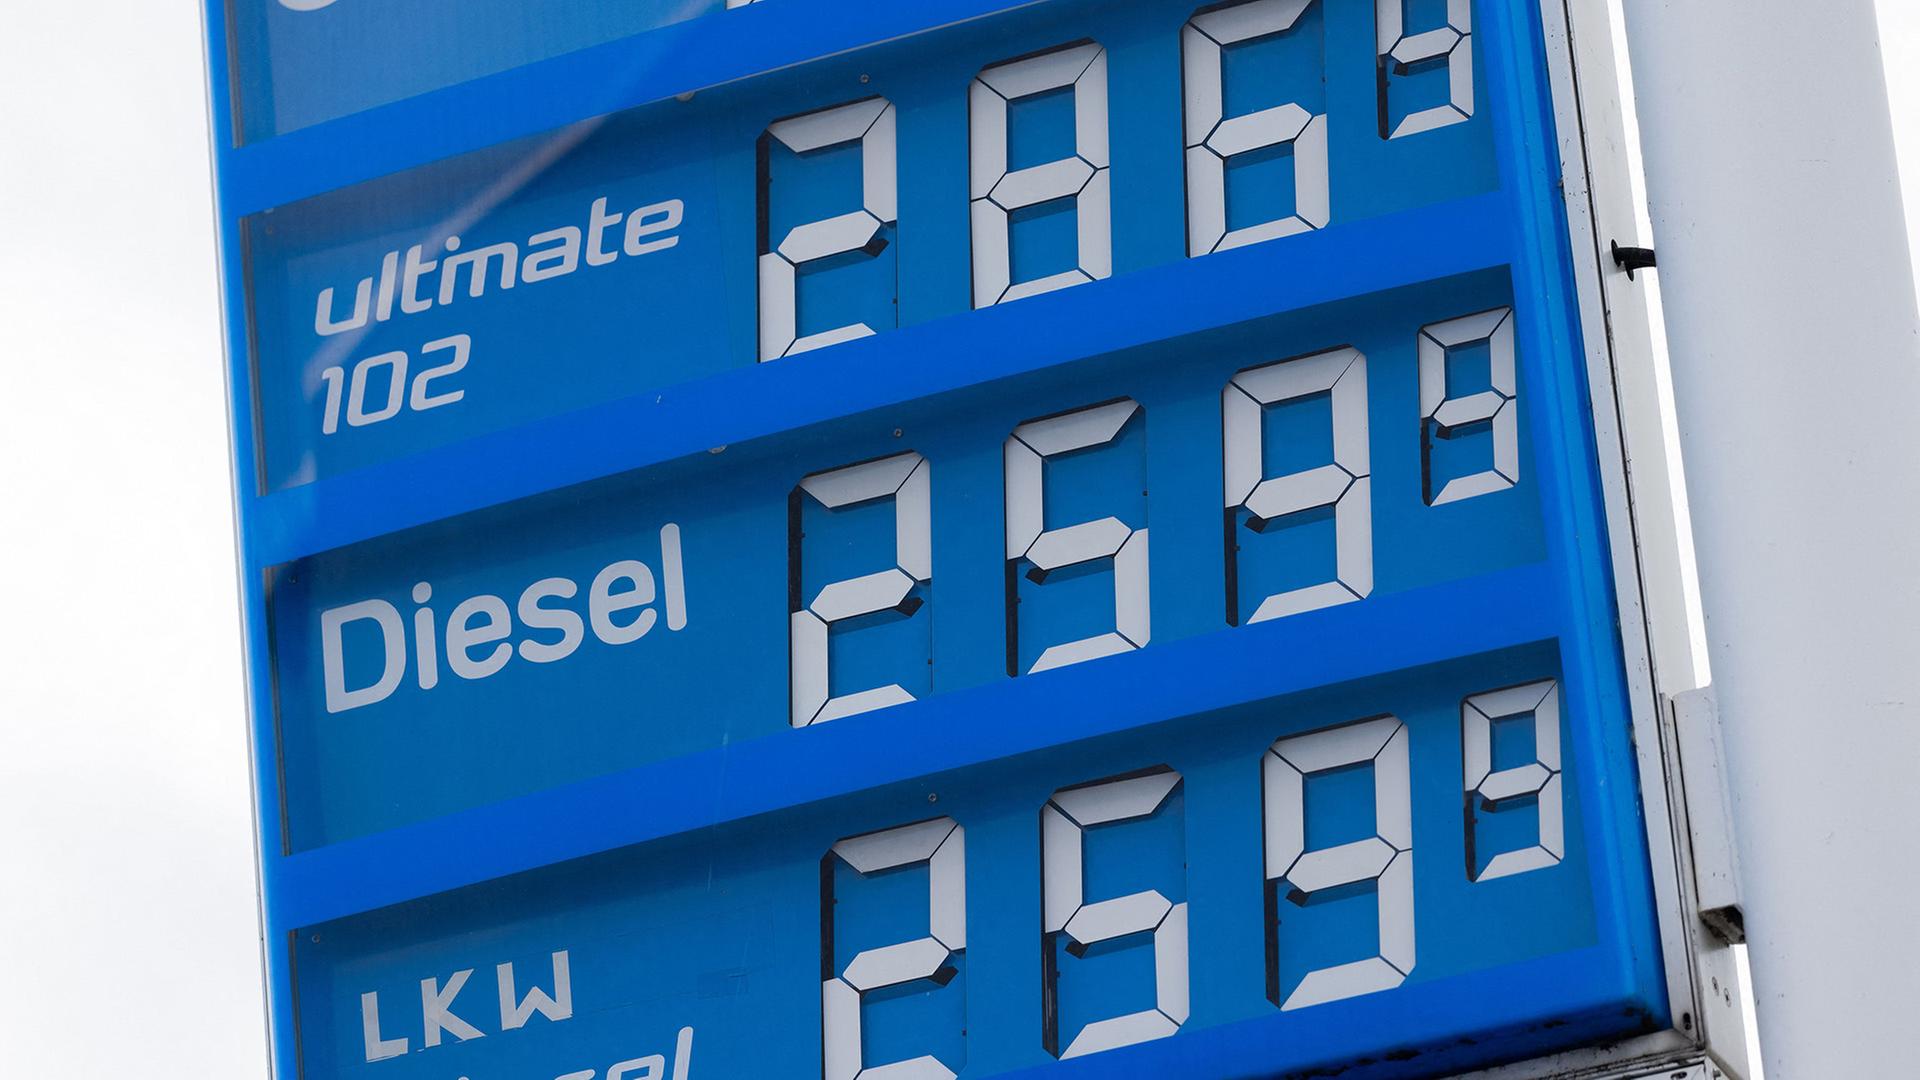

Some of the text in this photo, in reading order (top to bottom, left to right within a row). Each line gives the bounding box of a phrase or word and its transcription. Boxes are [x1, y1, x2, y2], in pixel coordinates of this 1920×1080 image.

[315, 196, 684, 336] ultimate
[320, 334, 471, 436] 102
[320, 522, 688, 714] Diesel
[361, 949, 573, 1063] LKW
